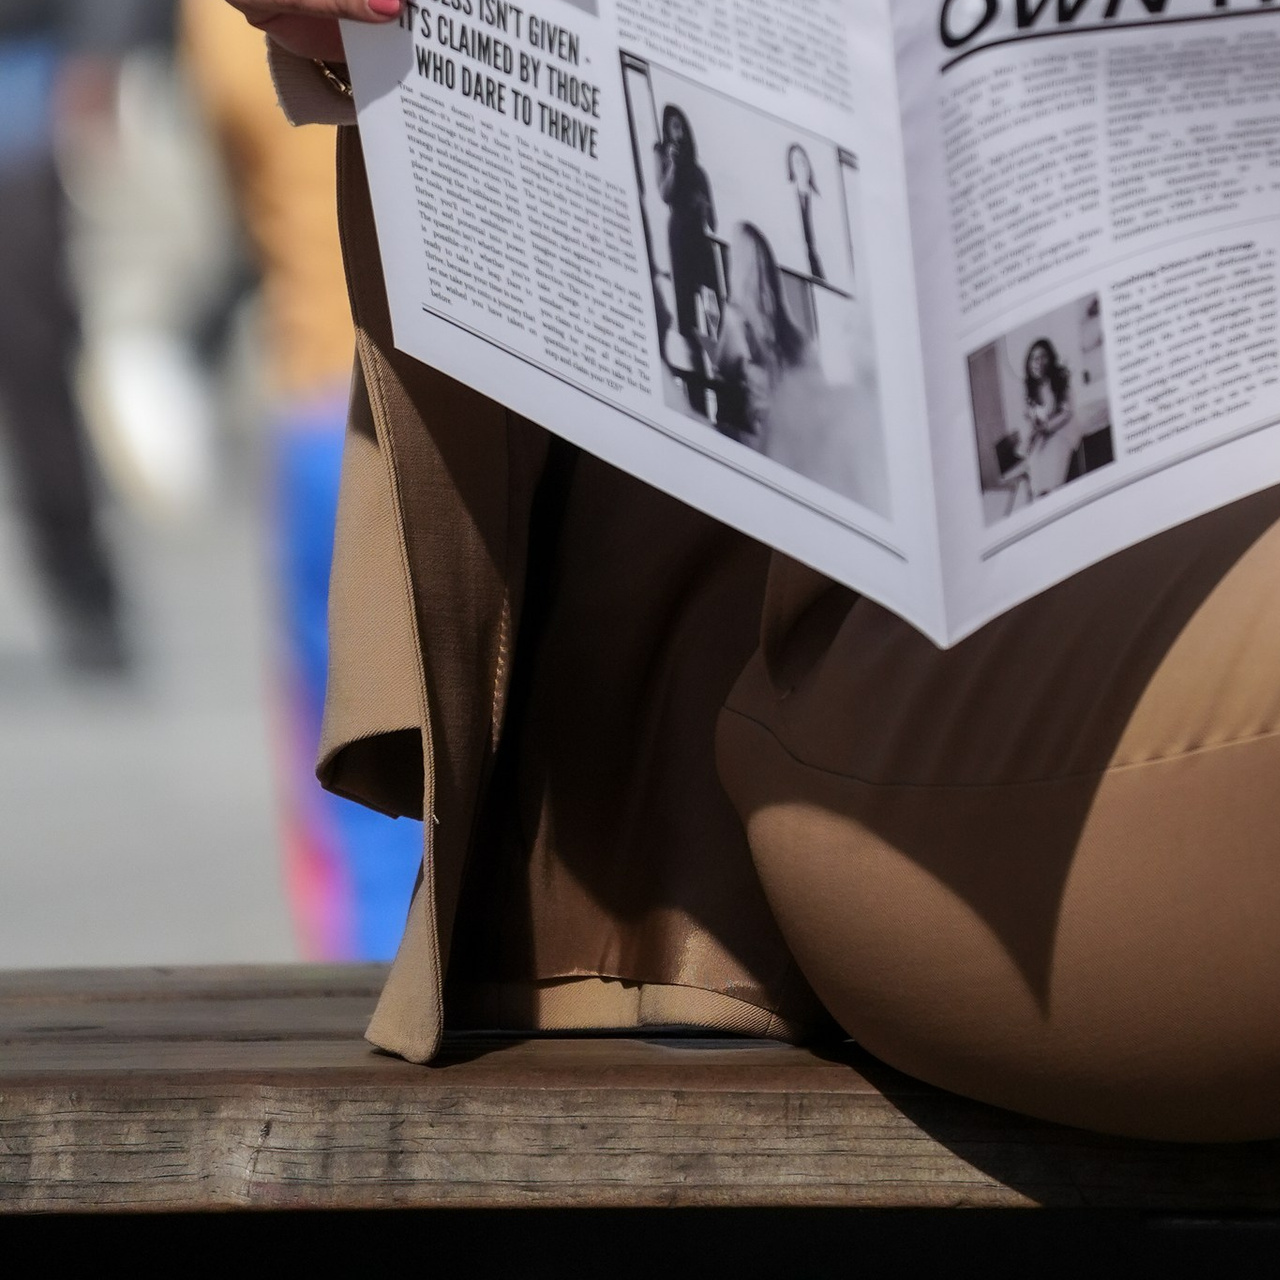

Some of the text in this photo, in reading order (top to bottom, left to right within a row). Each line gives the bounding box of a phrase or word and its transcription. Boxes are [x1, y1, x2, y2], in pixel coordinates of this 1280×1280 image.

[437, 14, 513, 75] CLAIMED
[520, 50, 541, 89] BY
[547, 64, 600, 119] THOSE
[529, 14, 580, 66] GIVEN
[416, 43, 599, 160] WHO DARE TO THRIVE
